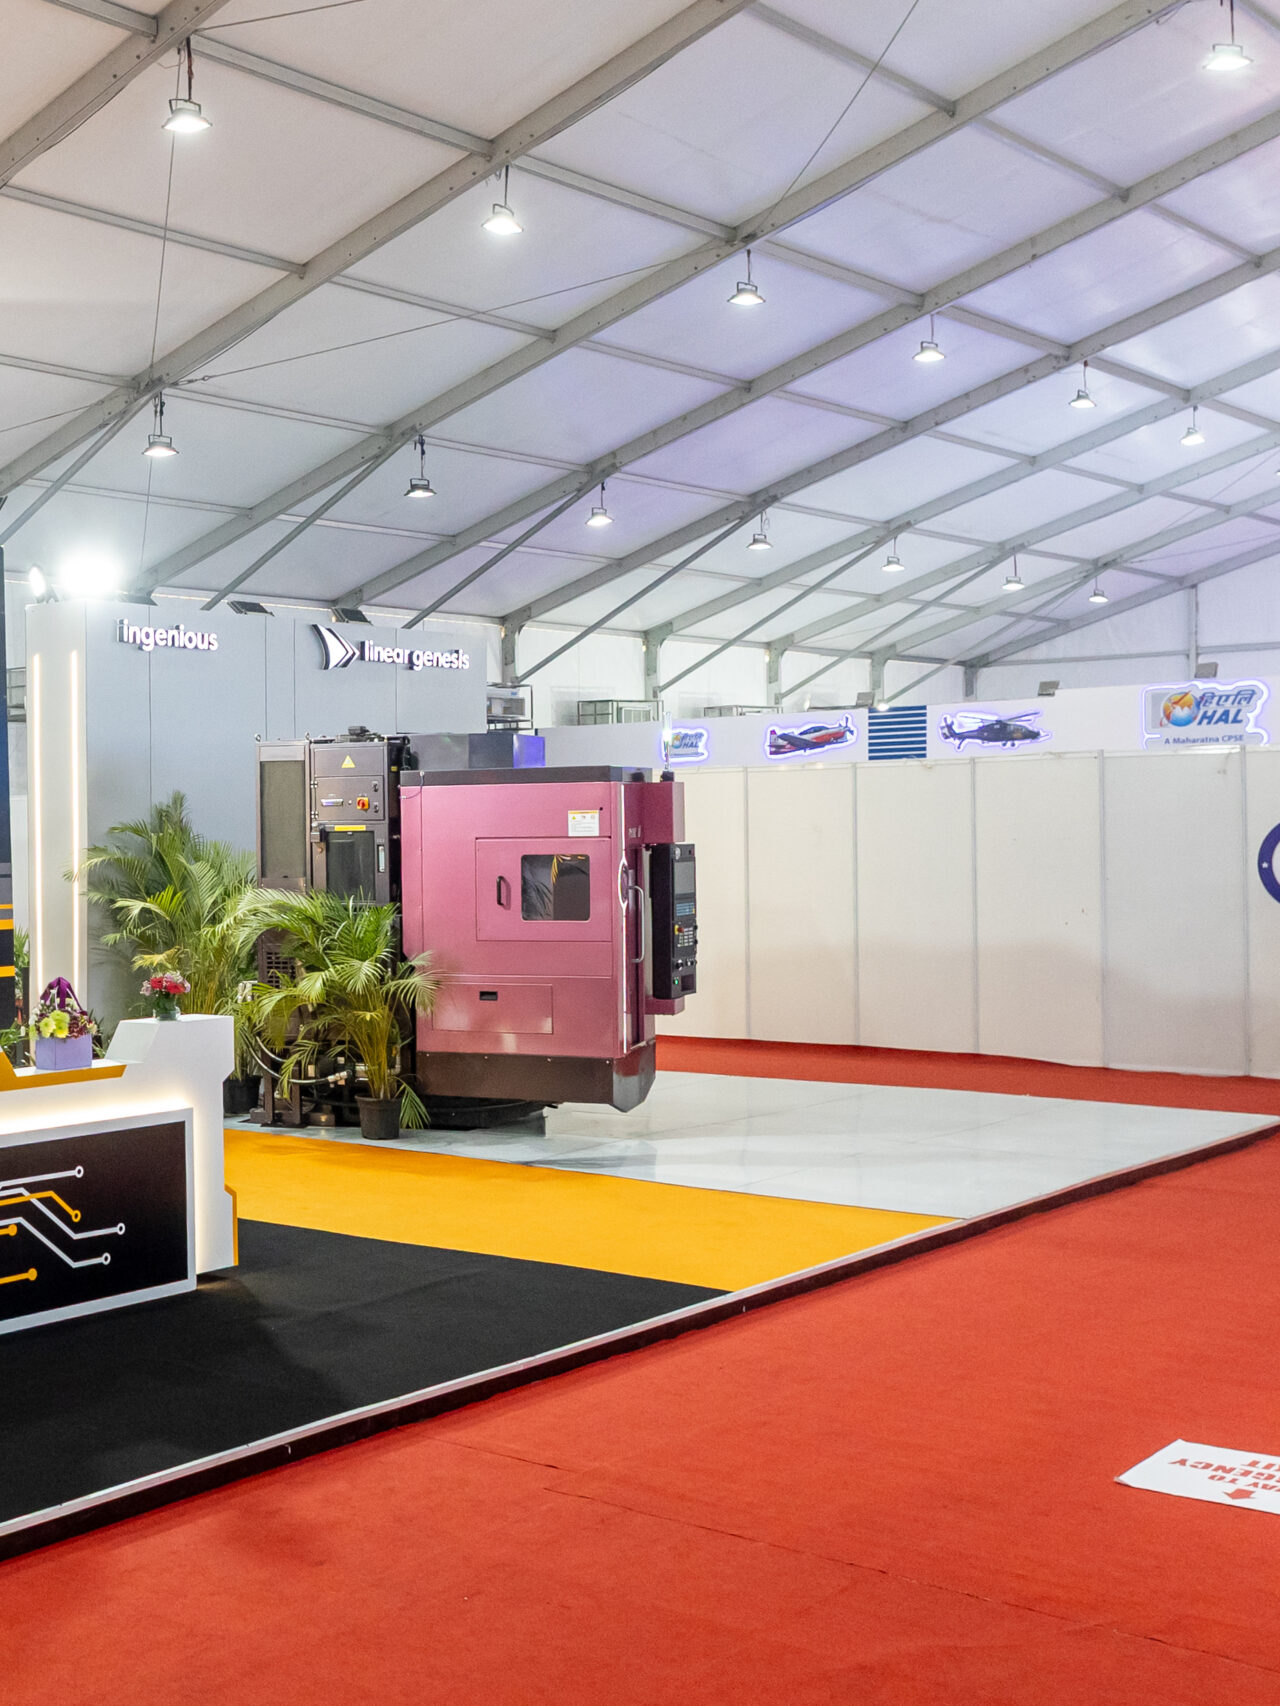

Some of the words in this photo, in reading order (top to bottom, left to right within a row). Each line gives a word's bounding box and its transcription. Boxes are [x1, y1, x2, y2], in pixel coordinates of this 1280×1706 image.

[123, 618, 219, 651] ingenious
[364, 640, 410, 664] linear
[412, 648, 470, 672] genesis
[1197, 709, 1244, 726] HAL
[1173, 735, 1220, 744] Maharatna
[1167, 1458, 1280, 1484] GENCY
